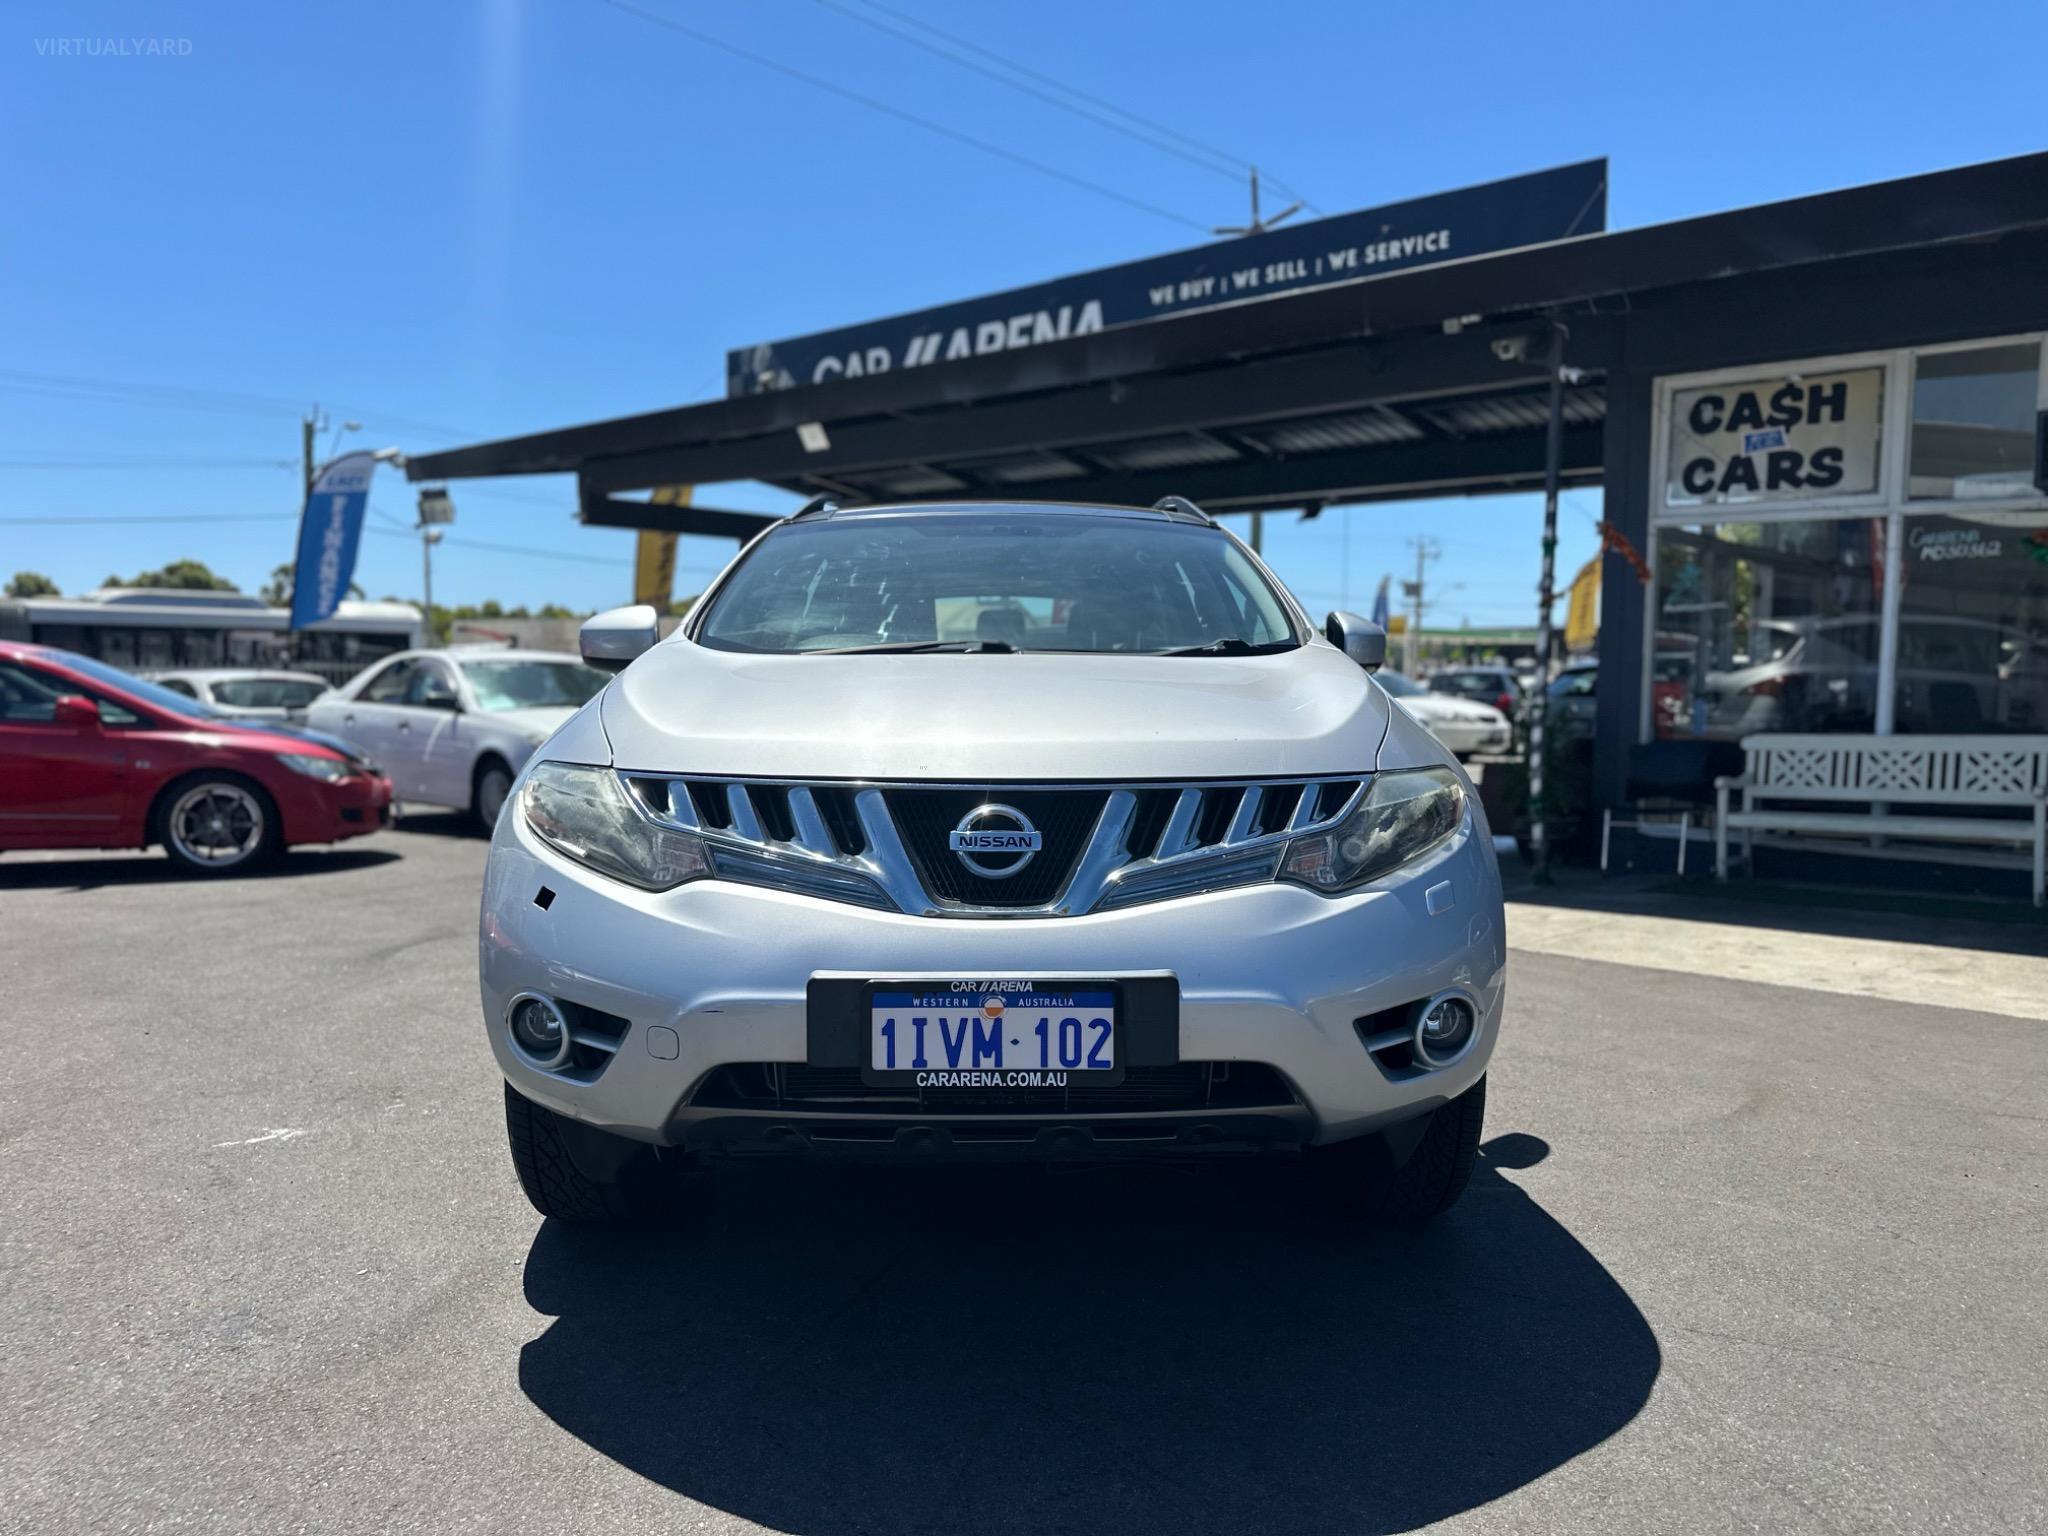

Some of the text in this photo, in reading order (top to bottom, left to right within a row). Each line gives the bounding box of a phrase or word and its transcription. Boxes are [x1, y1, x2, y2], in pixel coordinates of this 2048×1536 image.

[1149, 286, 1175, 306] WE
[1179, 277, 1216, 301] BUY
[1232, 268, 1260, 288] WE
[1265, 259, 1308, 284] SELL
[1328, 248, 1359, 270] WE
[1364, 230, 1451, 264] SERVICE
[1689, 381, 1848, 435] CA$H
[1682, 447, 1844, 494] CARS
[959, 836, 1032, 848] NISSAN
[912, 998, 1075, 1007] WESTERN AUSTRALIA
[916, 1072, 1068, 1087] CARARENA.COM.AU
